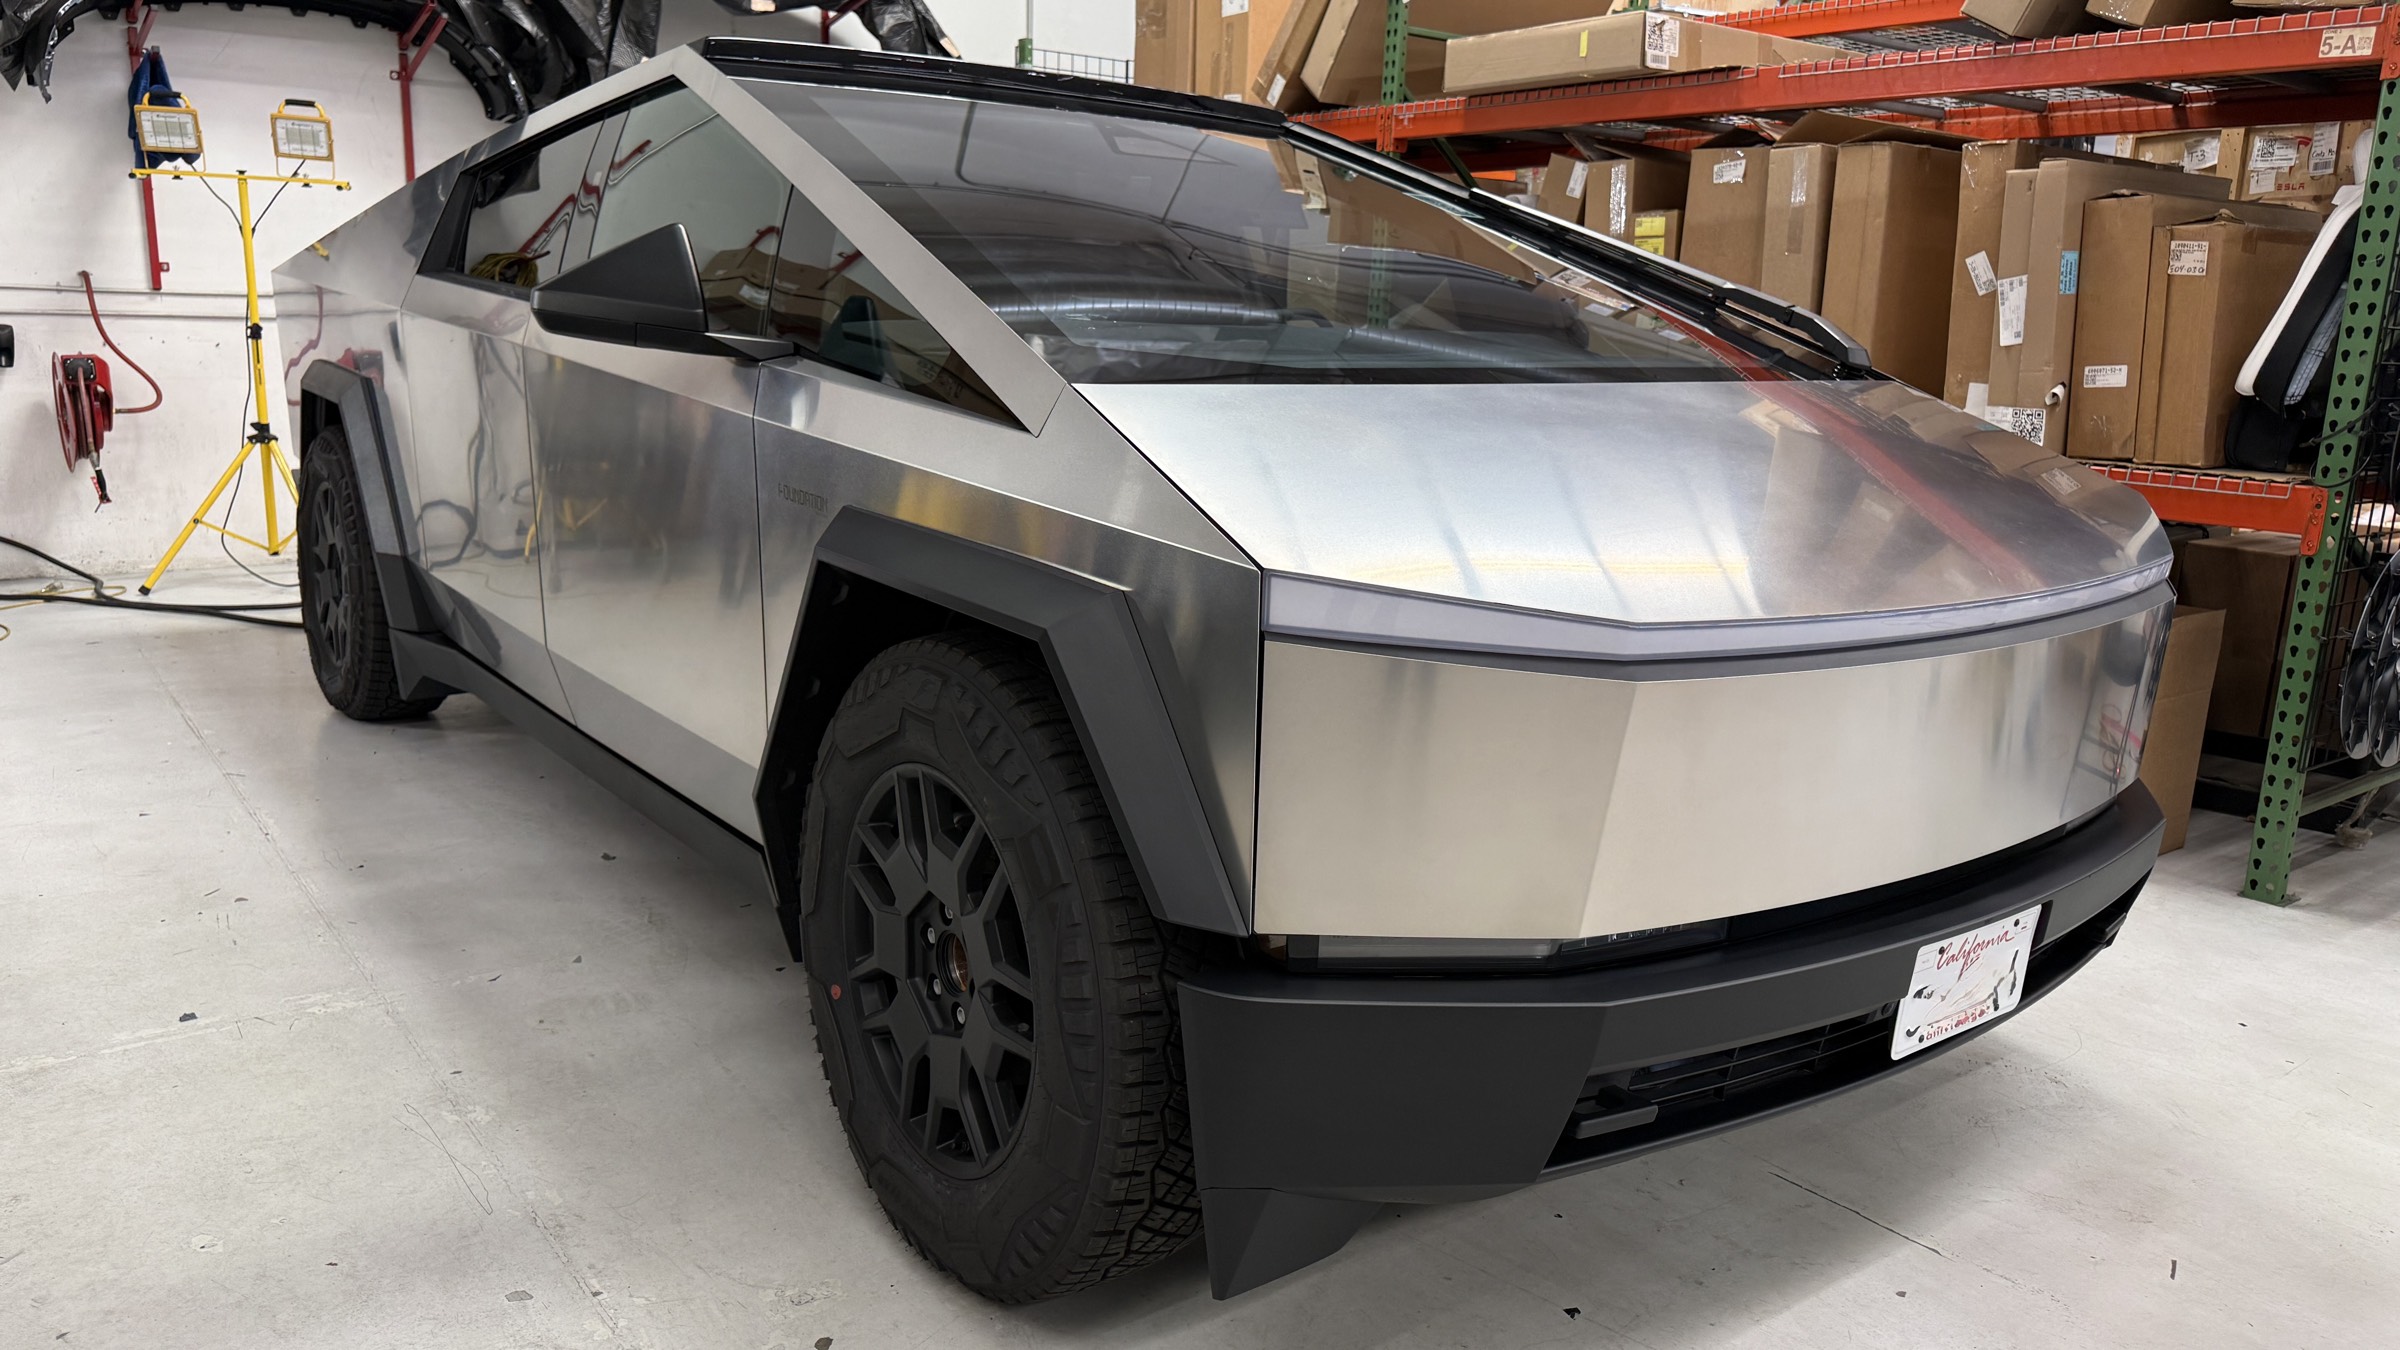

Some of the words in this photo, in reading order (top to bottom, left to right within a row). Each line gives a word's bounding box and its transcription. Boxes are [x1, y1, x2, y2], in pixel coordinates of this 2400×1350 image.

[2320, 34, 2356, 55] 5-A
[2276, 182, 2305, 191] ESLA
[1936, 926, 2015, 982] California
